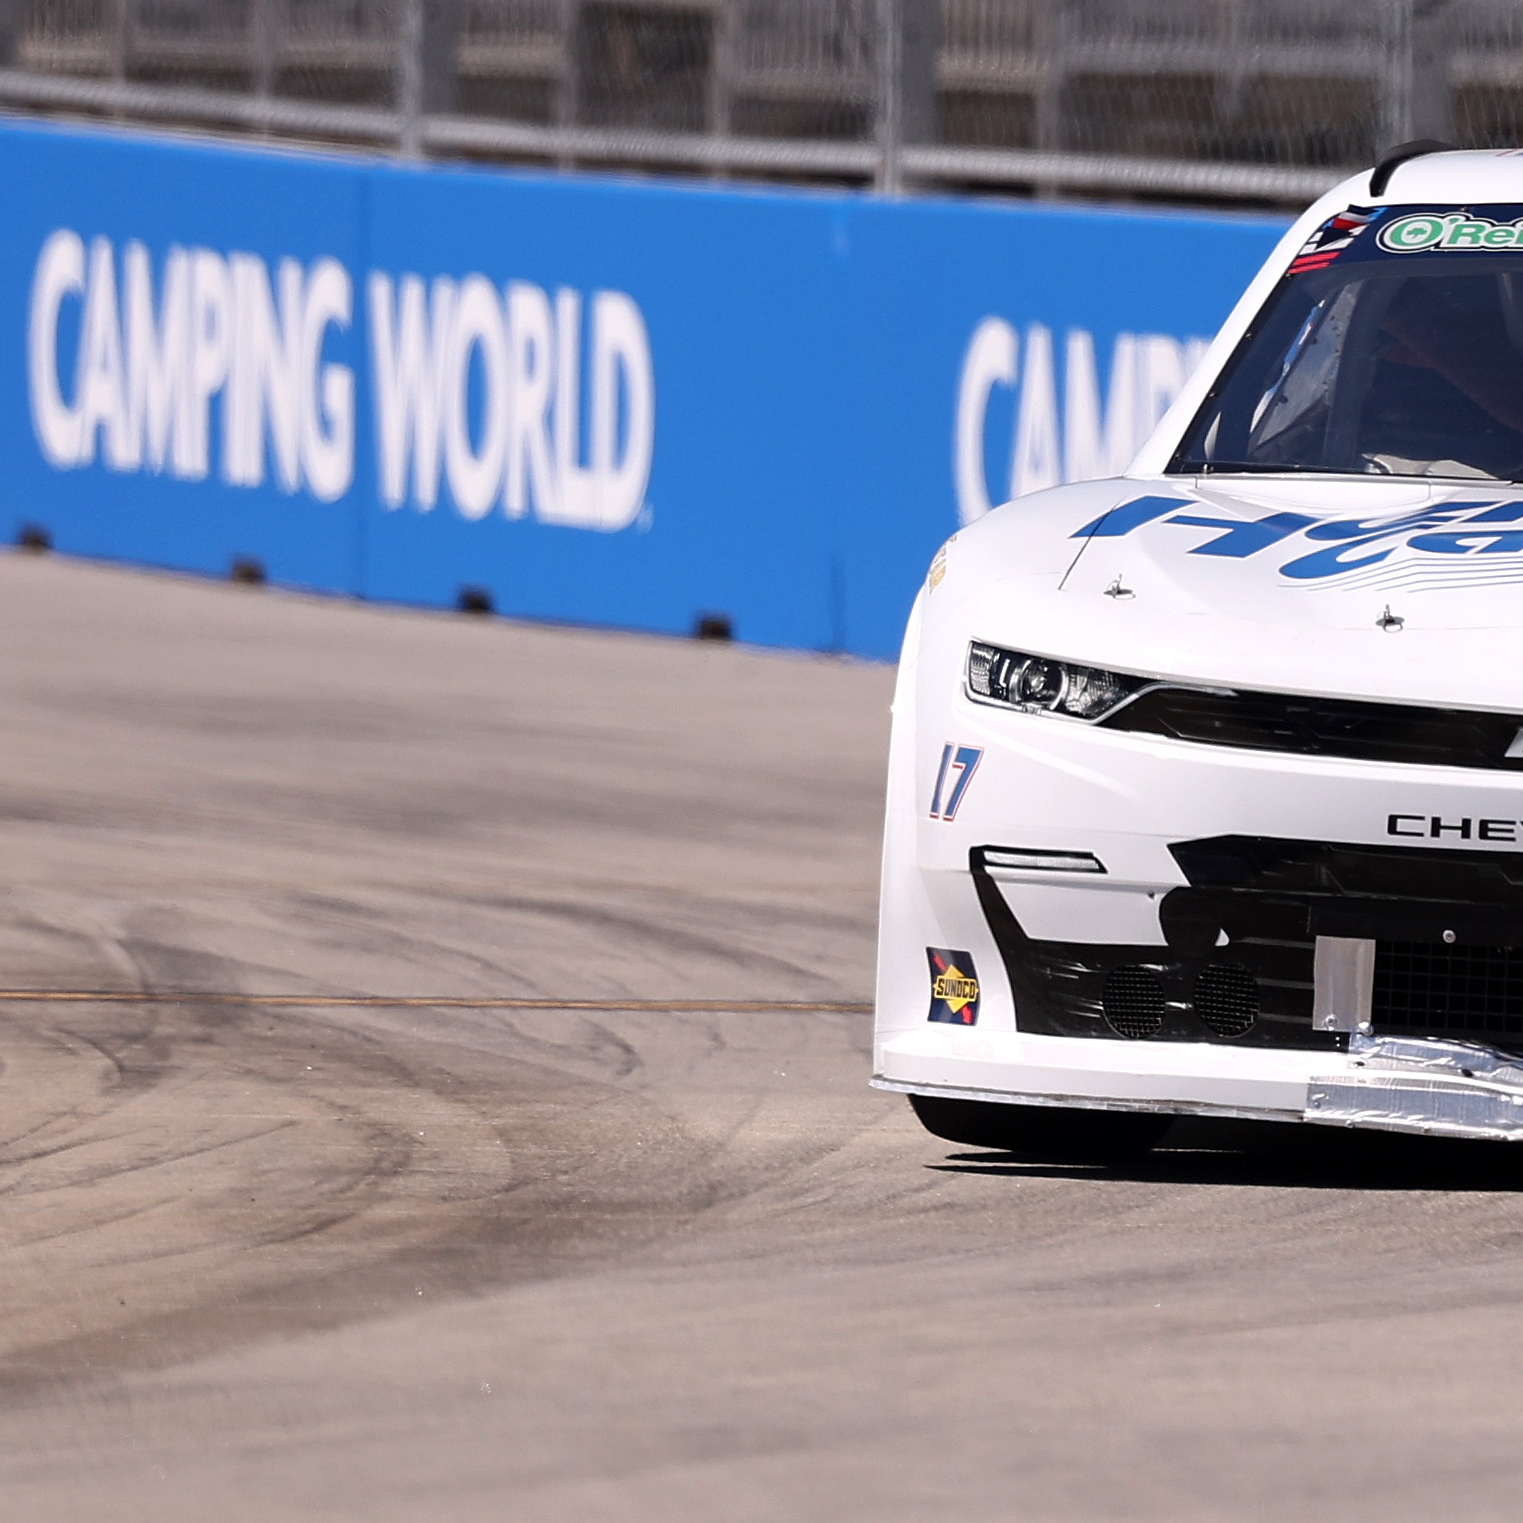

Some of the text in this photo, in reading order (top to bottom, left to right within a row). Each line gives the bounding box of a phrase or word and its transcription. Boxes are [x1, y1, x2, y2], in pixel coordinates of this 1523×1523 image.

[27, 228, 655, 532] CAMPING WORLD
[955, 316, 1217, 524] CAMP
[928, 741, 984, 822] 17
[936, 977, 976, 1000] SUNOCO
